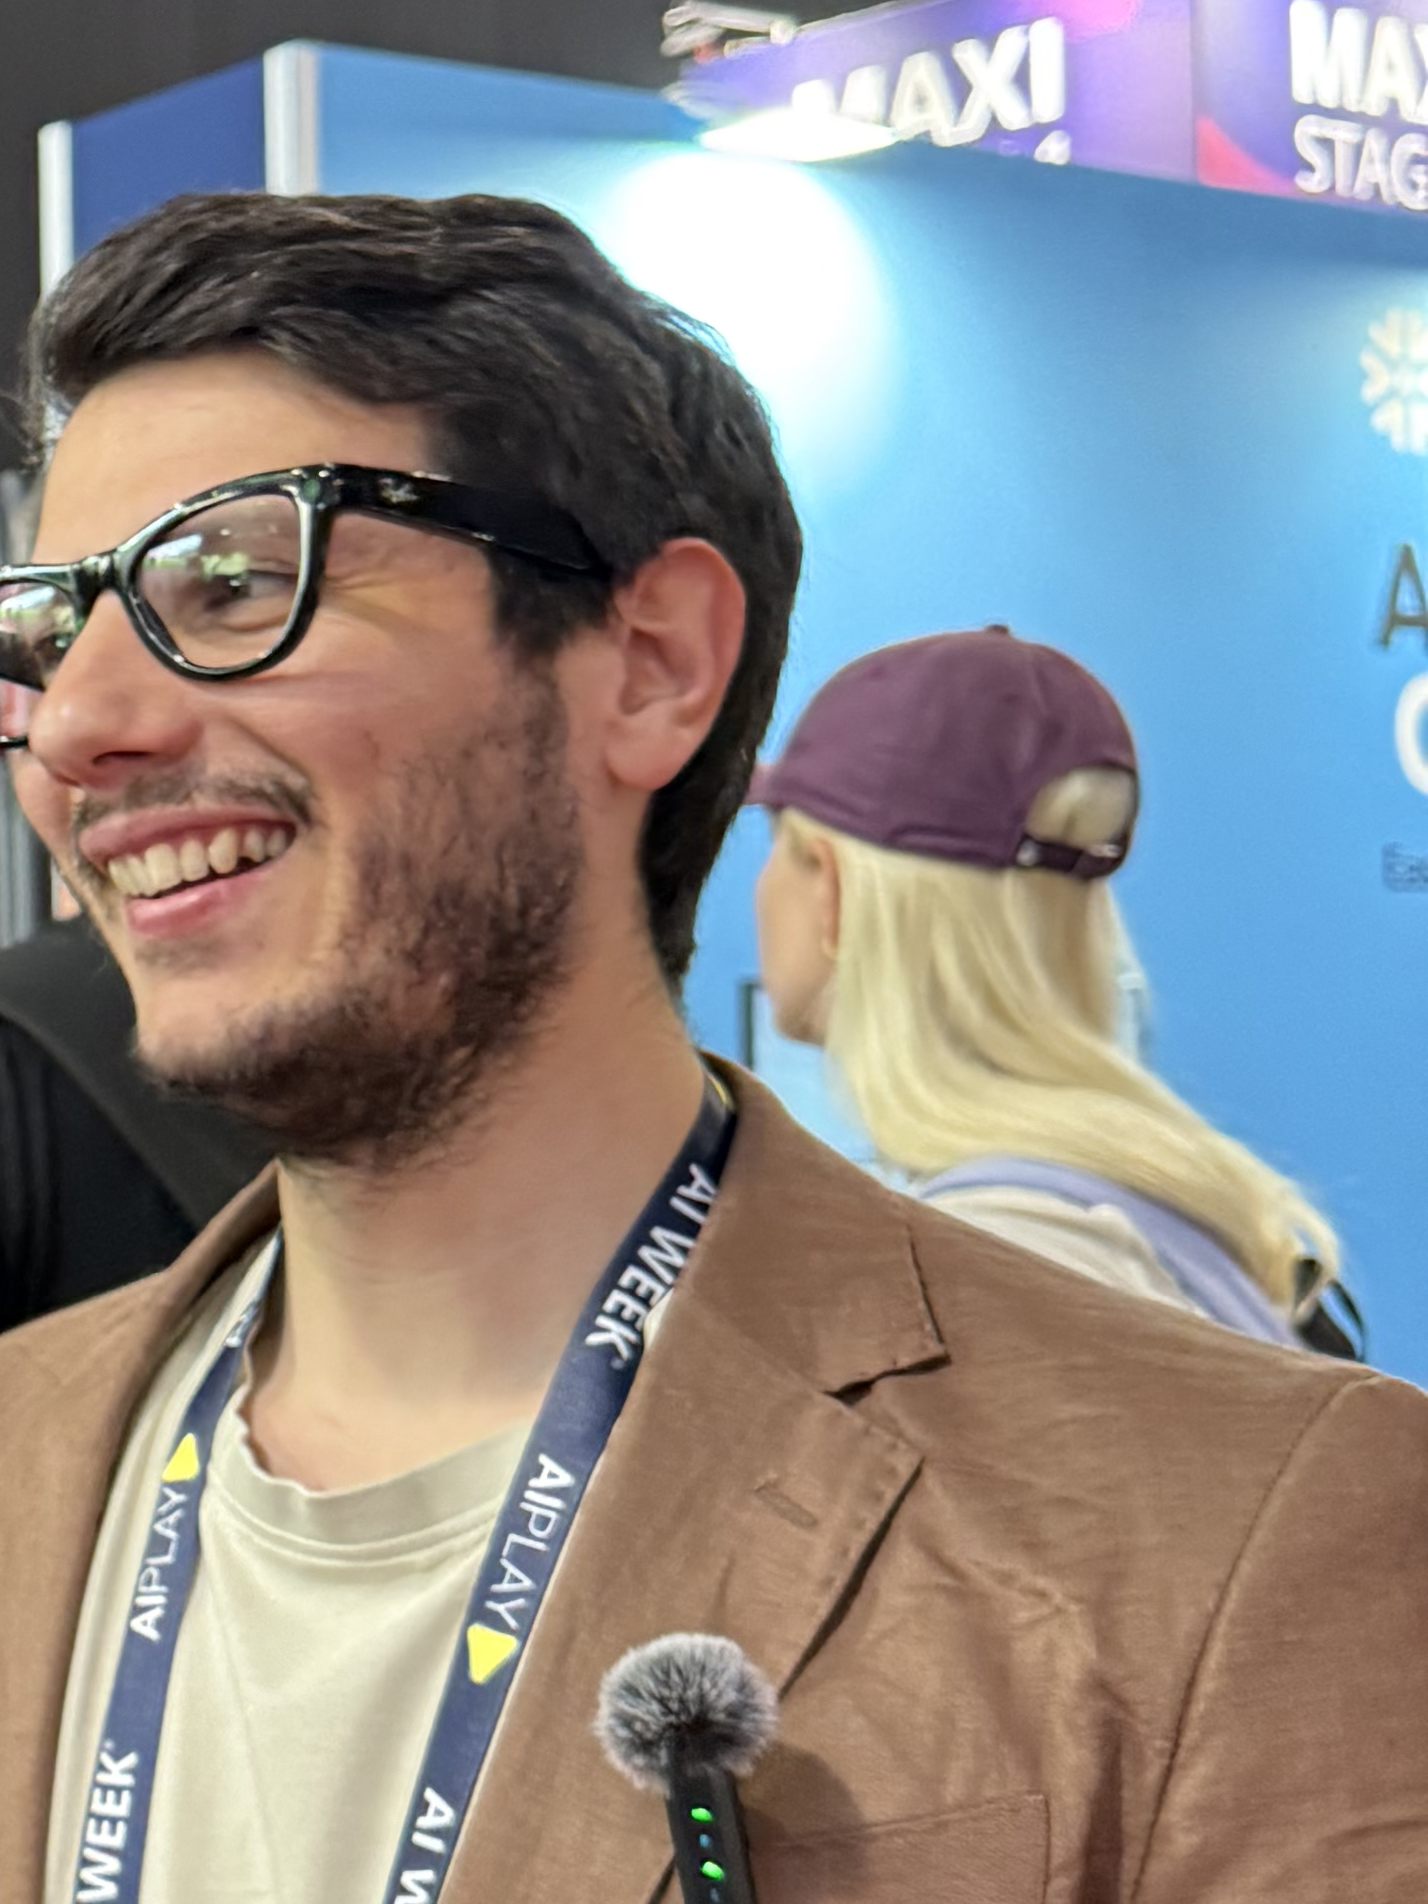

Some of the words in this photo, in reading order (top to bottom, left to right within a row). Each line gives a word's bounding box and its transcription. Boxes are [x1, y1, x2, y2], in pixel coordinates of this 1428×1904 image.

[669, 1163, 717, 1224] AI
[585, 1226, 696, 1360] WEEK
[129, 1487, 188, 1643] AIPLAY
[484, 1452, 575, 1631] AIPLAY
[76, 1750, 139, 1904] WEEK
[415, 1786, 456, 1853] AI
